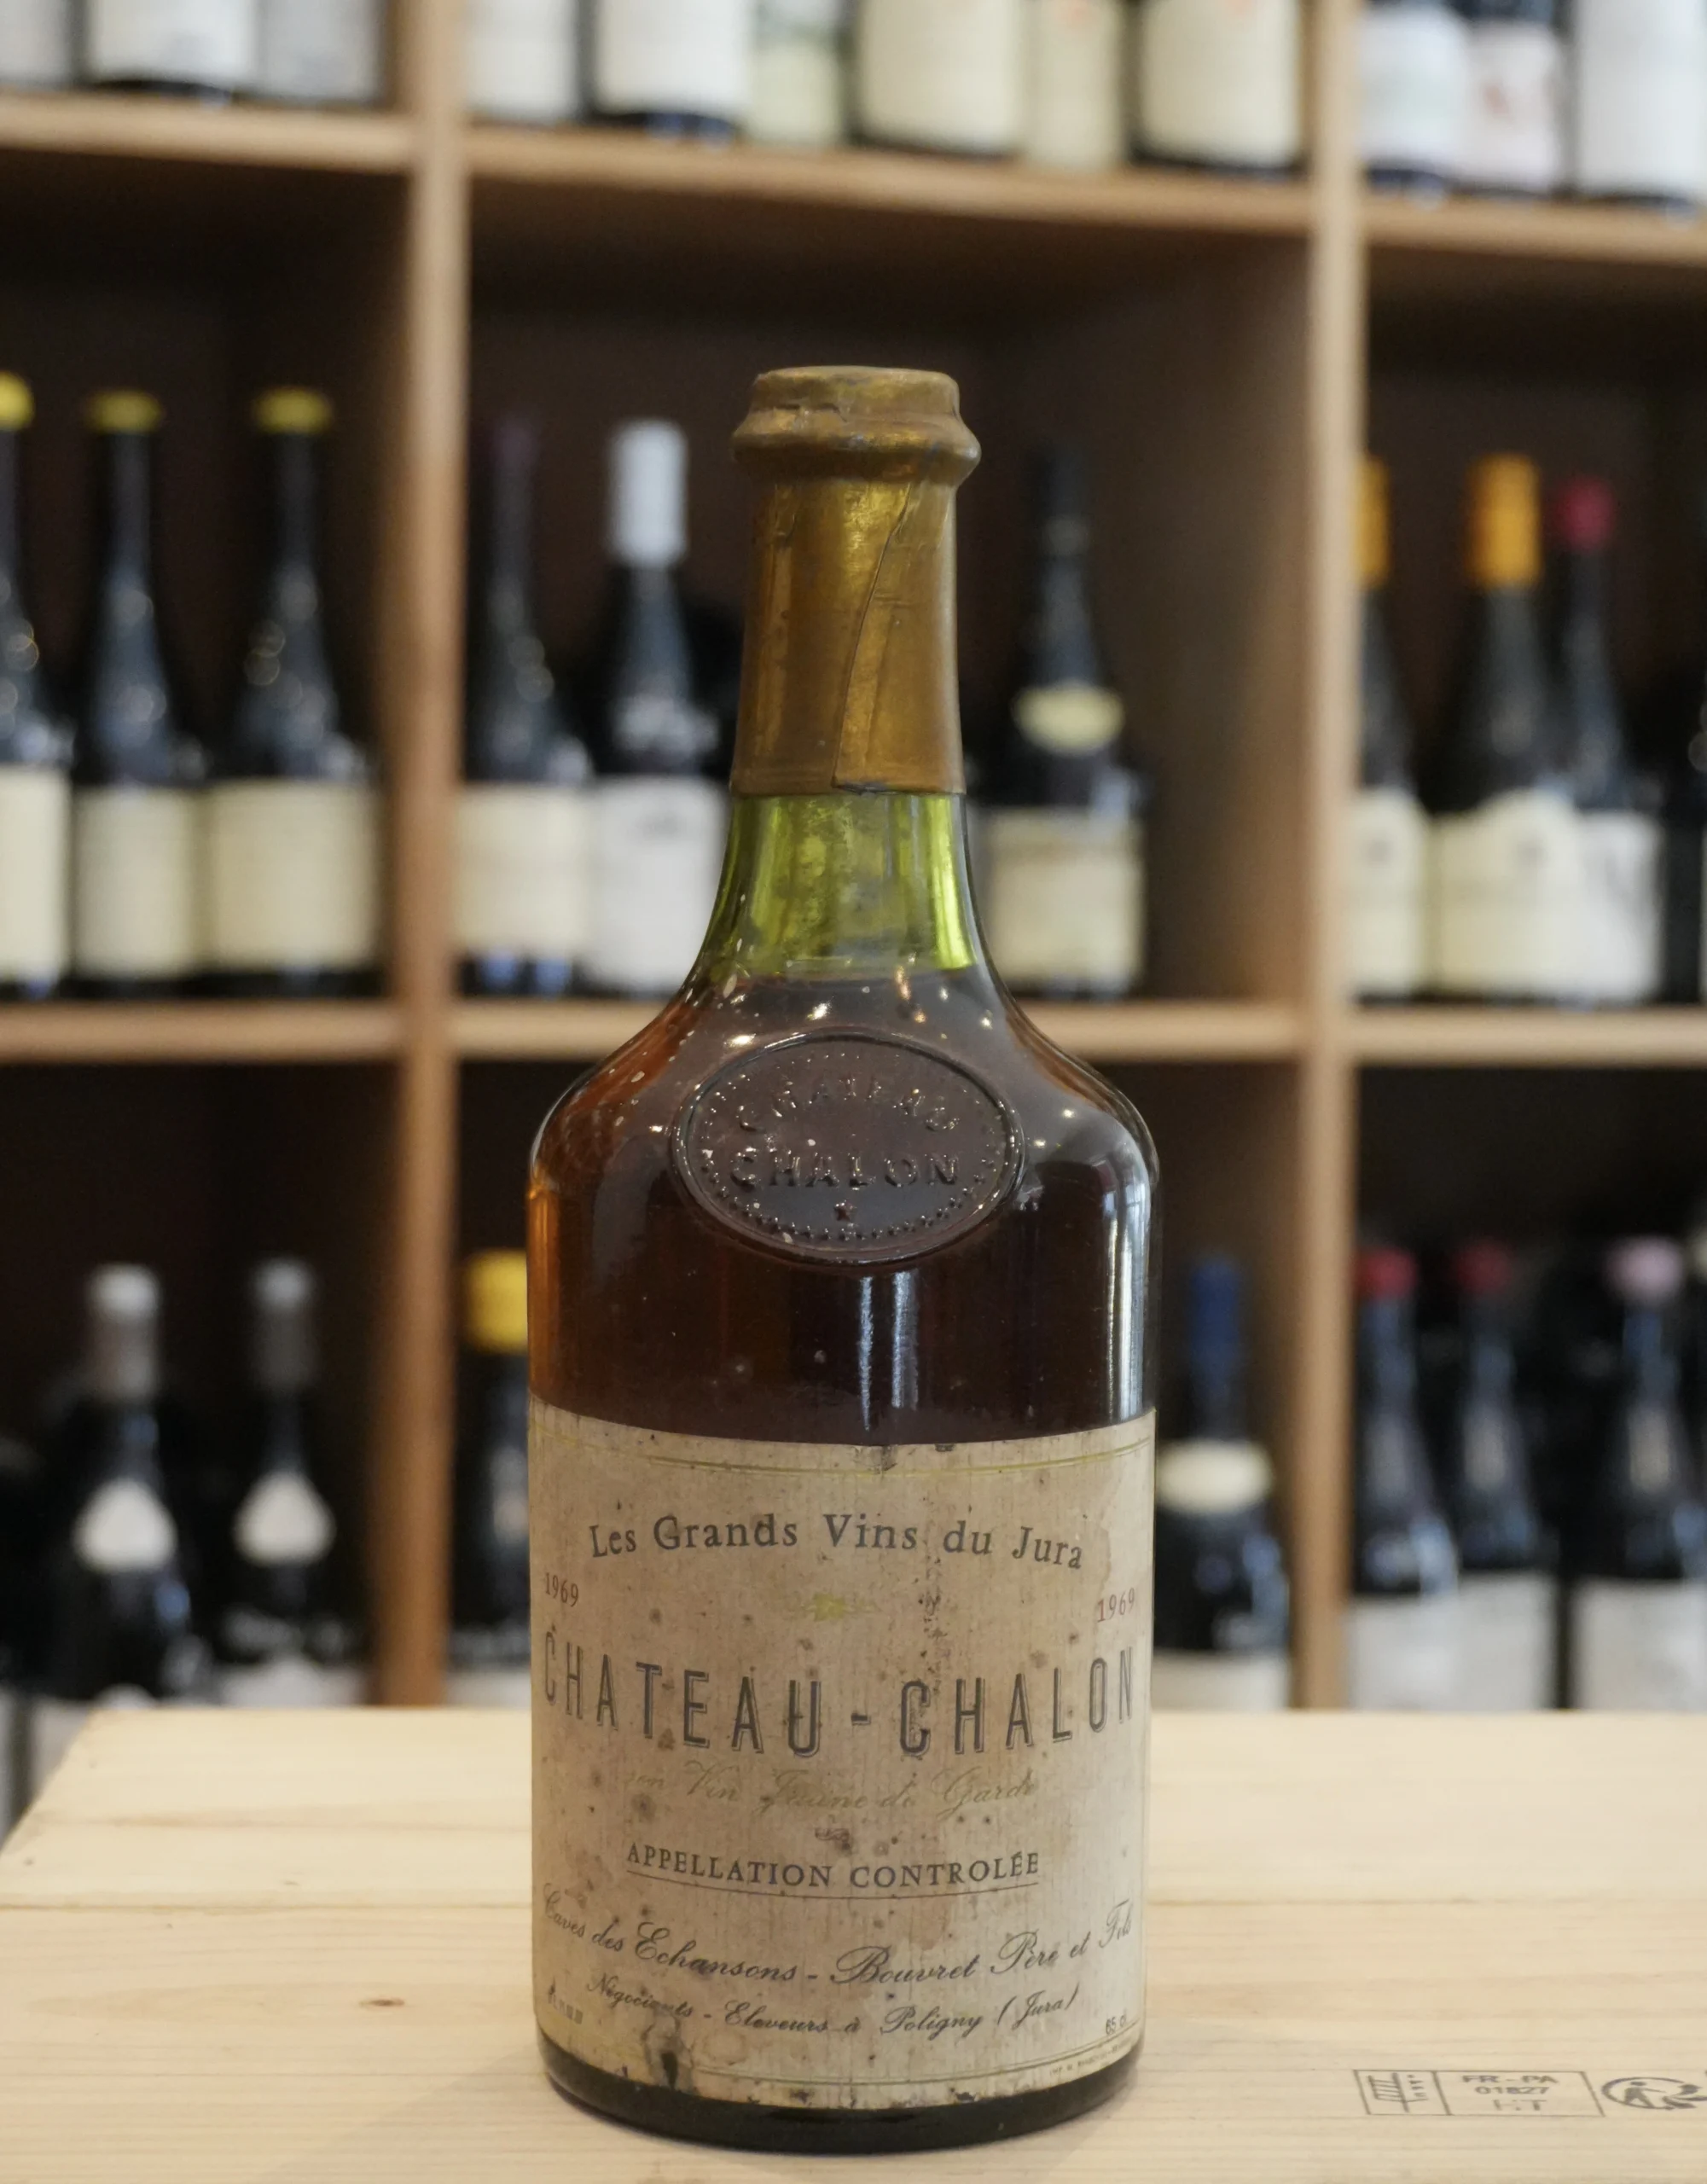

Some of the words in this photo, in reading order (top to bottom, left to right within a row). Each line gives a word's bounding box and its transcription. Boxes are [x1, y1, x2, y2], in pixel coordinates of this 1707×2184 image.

[730, 1147, 960, 1190] CHALON
[589, 1525, 637, 1558] Les
[653, 1513, 798, 1550] Grands
[824, 1513, 919, 1550] Vins
[943, 1520, 993, 1555] du
[1012, 1525, 1083, 1571] Jura
[545, 1572, 579, 1607] 1969
[1097, 1588, 1135, 1623] 1969
[683, 1759, 741, 1802] Vin
[627, 1842, 833, 1888] APPELLATION
[850, 1850, 1039, 1889] CONTROLÉE
[543, 1882, 586, 1937] Caves
[591, 1916, 625, 1952] des
[635, 1921, 798, 1982] Echansons
[830, 1945, 980, 1985] Bouvret
[1070, 1930, 1092, 1959] et
[1098, 1898, 1133, 1949] Fils
[880, 2006, 984, 2041] Poligny
[1474, 2086, 1551, 2094] 01827
